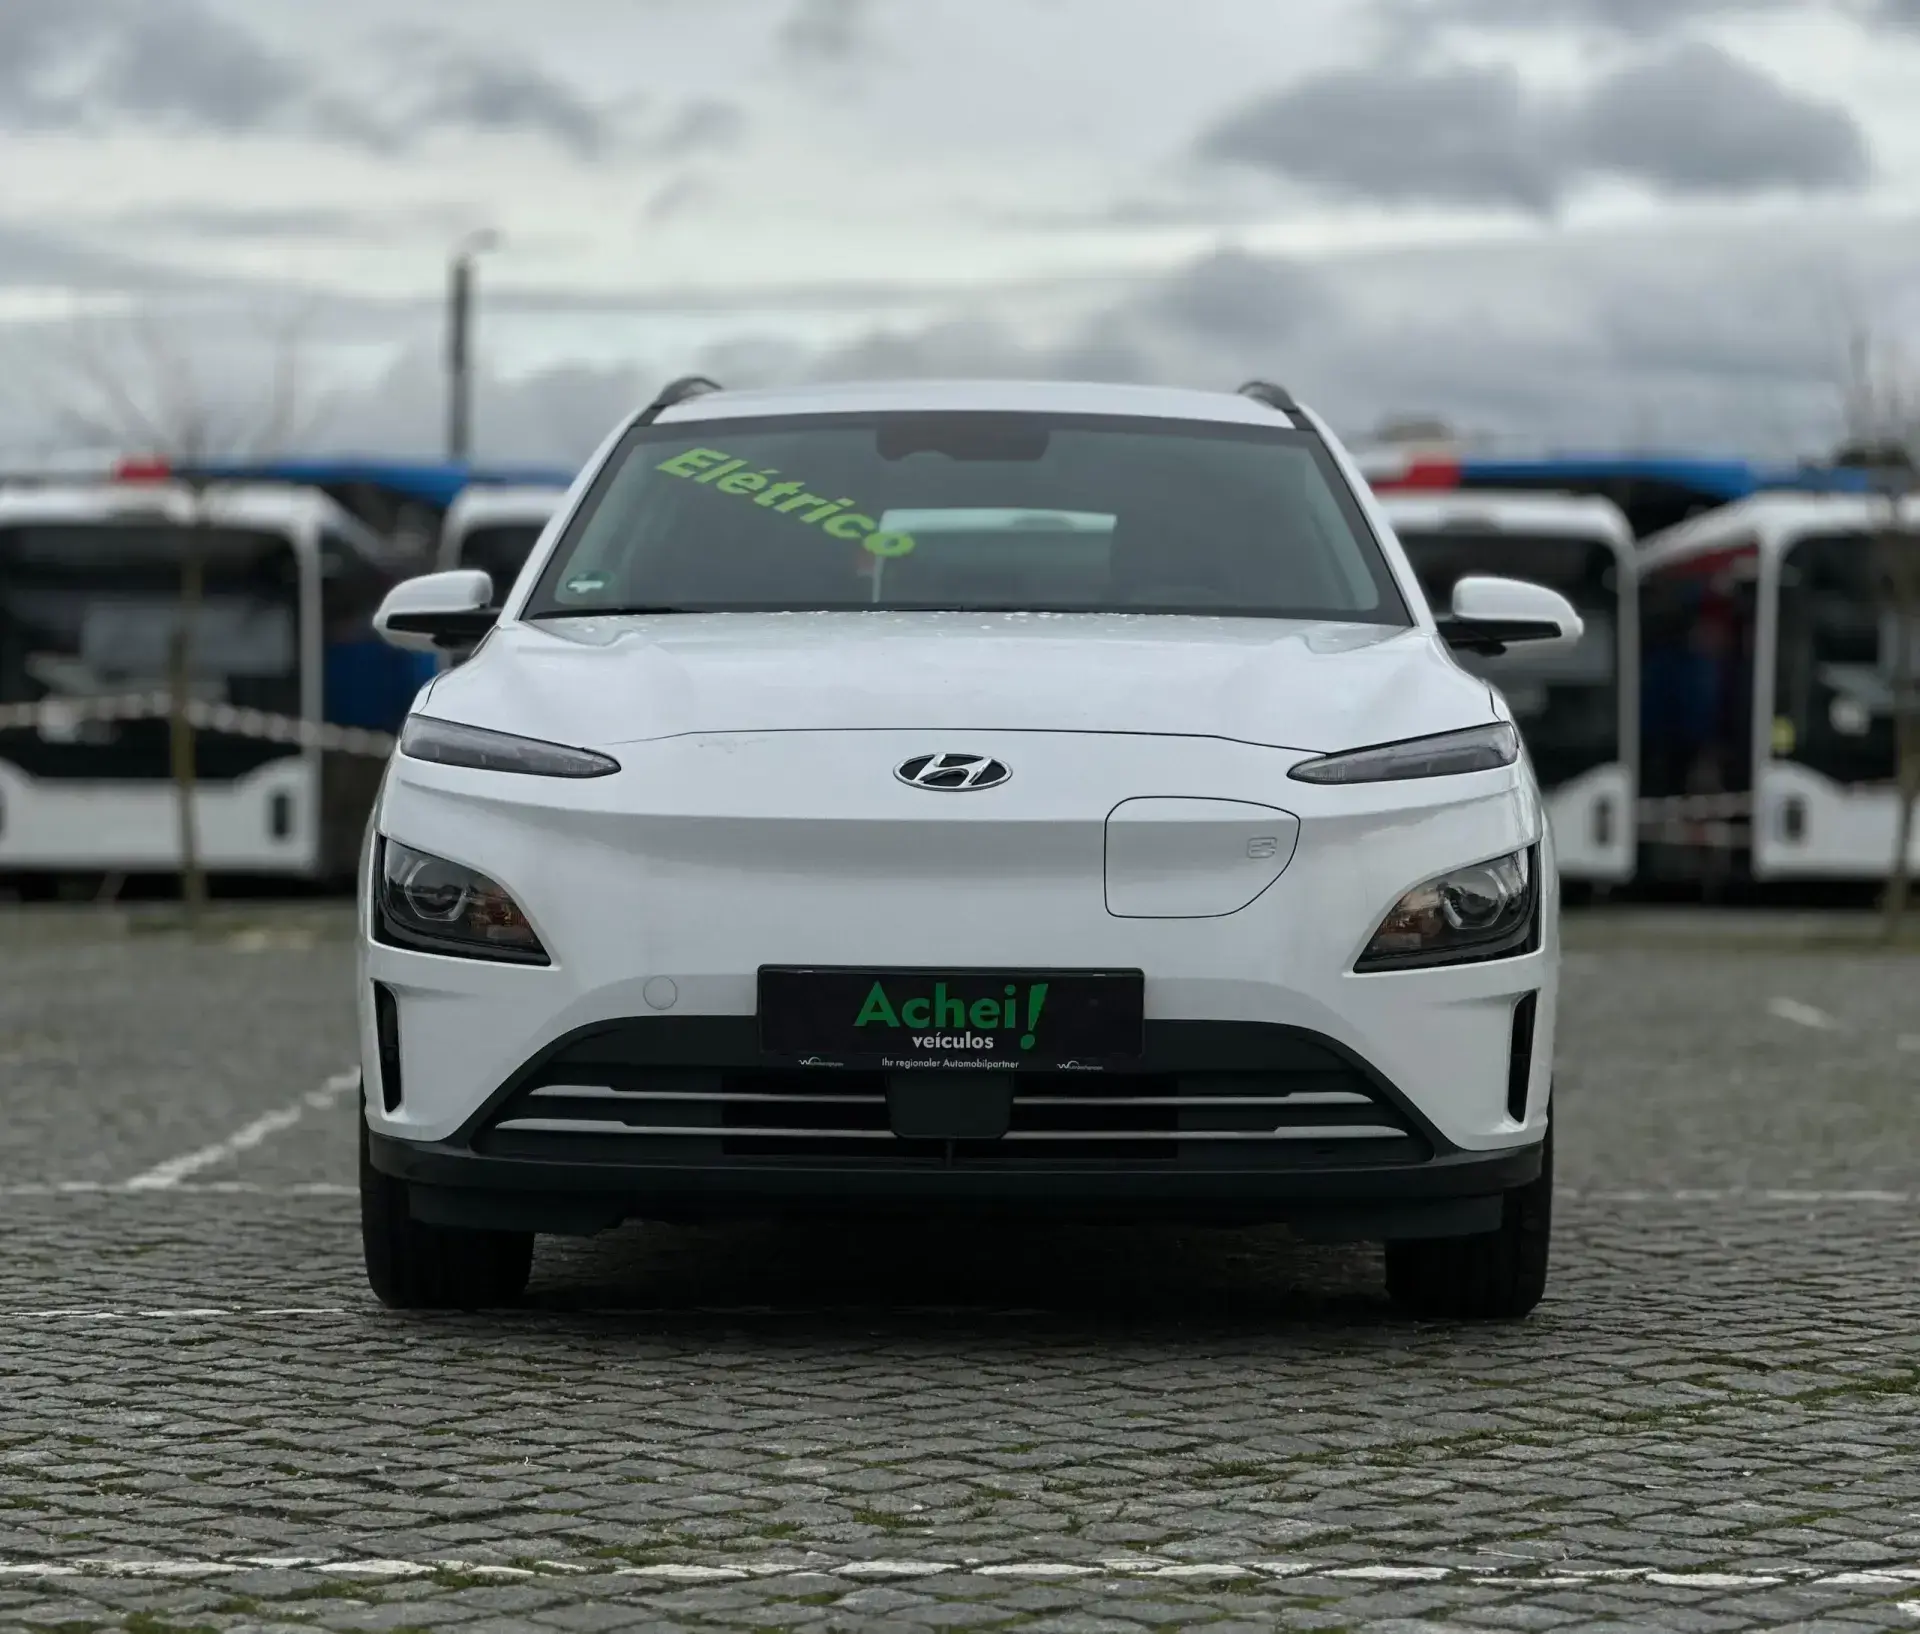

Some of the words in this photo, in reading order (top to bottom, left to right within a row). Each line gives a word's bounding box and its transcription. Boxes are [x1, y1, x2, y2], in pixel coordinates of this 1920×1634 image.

[655, 447, 915, 557] Elétrico
[853, 980, 1048, 1049] Achei!
[912, 1031, 994, 1049] veículos
[882, 1057, 894, 1067] Ihr
[896, 1057, 940, 1069] regionaler
[942, 1058, 1019, 1070] Automobilpartner
